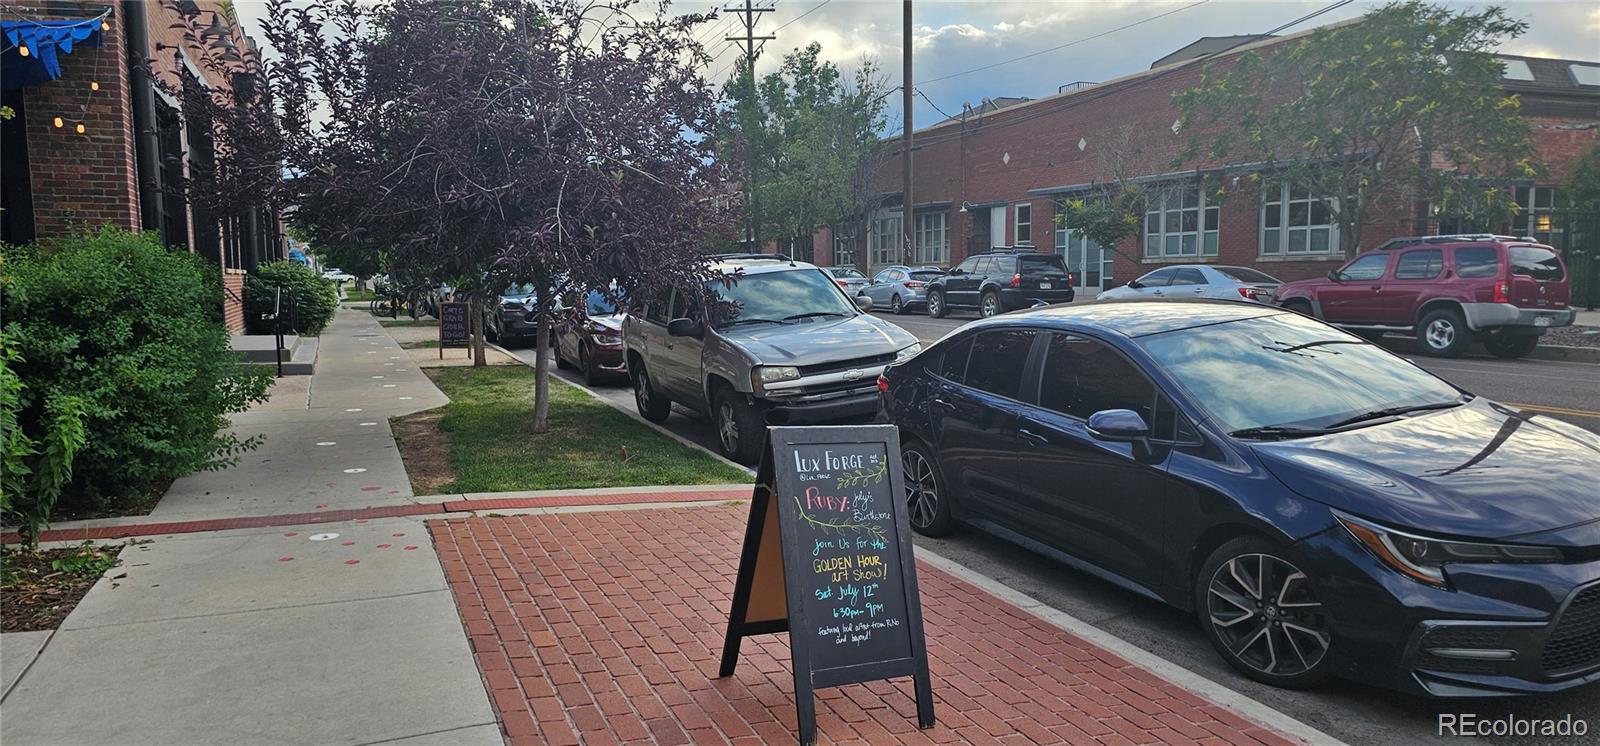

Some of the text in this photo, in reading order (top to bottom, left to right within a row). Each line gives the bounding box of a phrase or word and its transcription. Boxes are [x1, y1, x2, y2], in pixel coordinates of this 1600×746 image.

[825, 450, 865, 471] FORGE
[870, 539, 887, 550] the
[813, 555, 882, 573] GOLDEN HOUR
[837, 583, 859, 607] July
[871, 621, 886, 629] from
[835, 634, 847, 645] and
